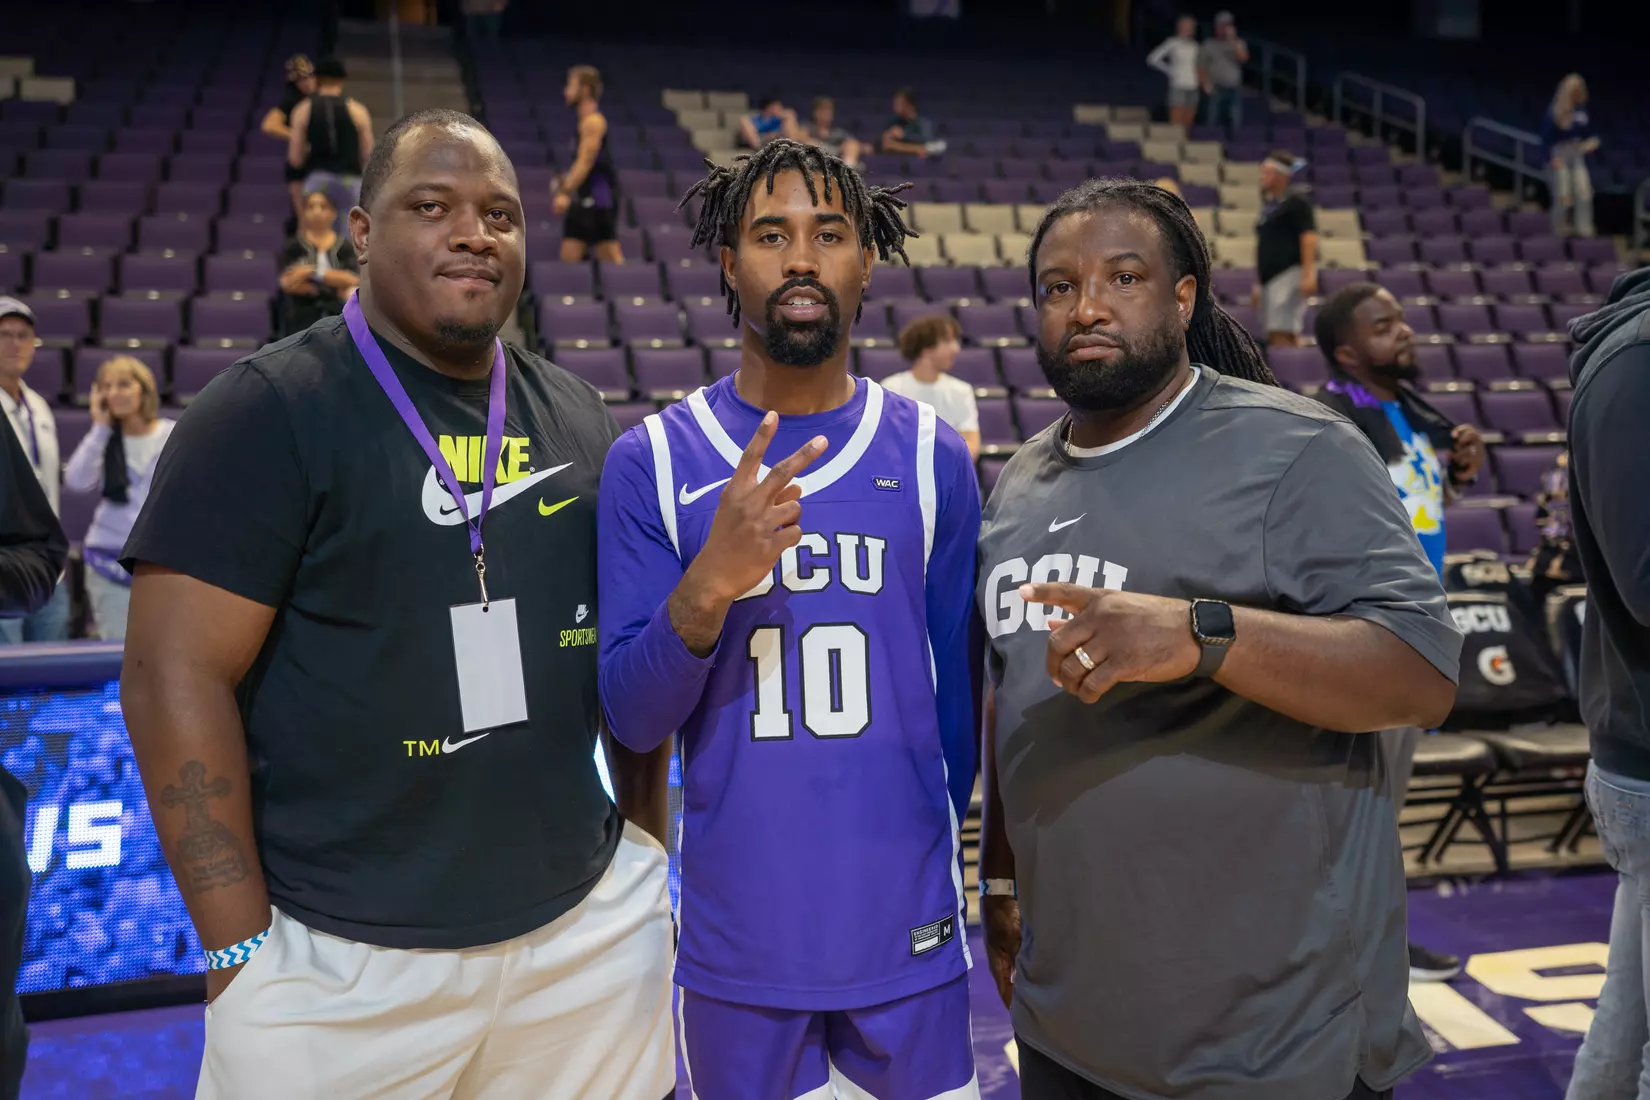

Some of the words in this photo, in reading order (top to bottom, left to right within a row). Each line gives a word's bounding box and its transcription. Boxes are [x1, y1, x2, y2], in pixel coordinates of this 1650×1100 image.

[875, 479, 899, 488] WAC
[1451, 605, 1512, 635] GCU
[559, 627, 597, 647] SPORTSWE
[1477, 645, 1516, 685] G
[746, 622, 872, 742] 10
[403, 739, 440, 757] TM
[943, 924, 951, 937] M
